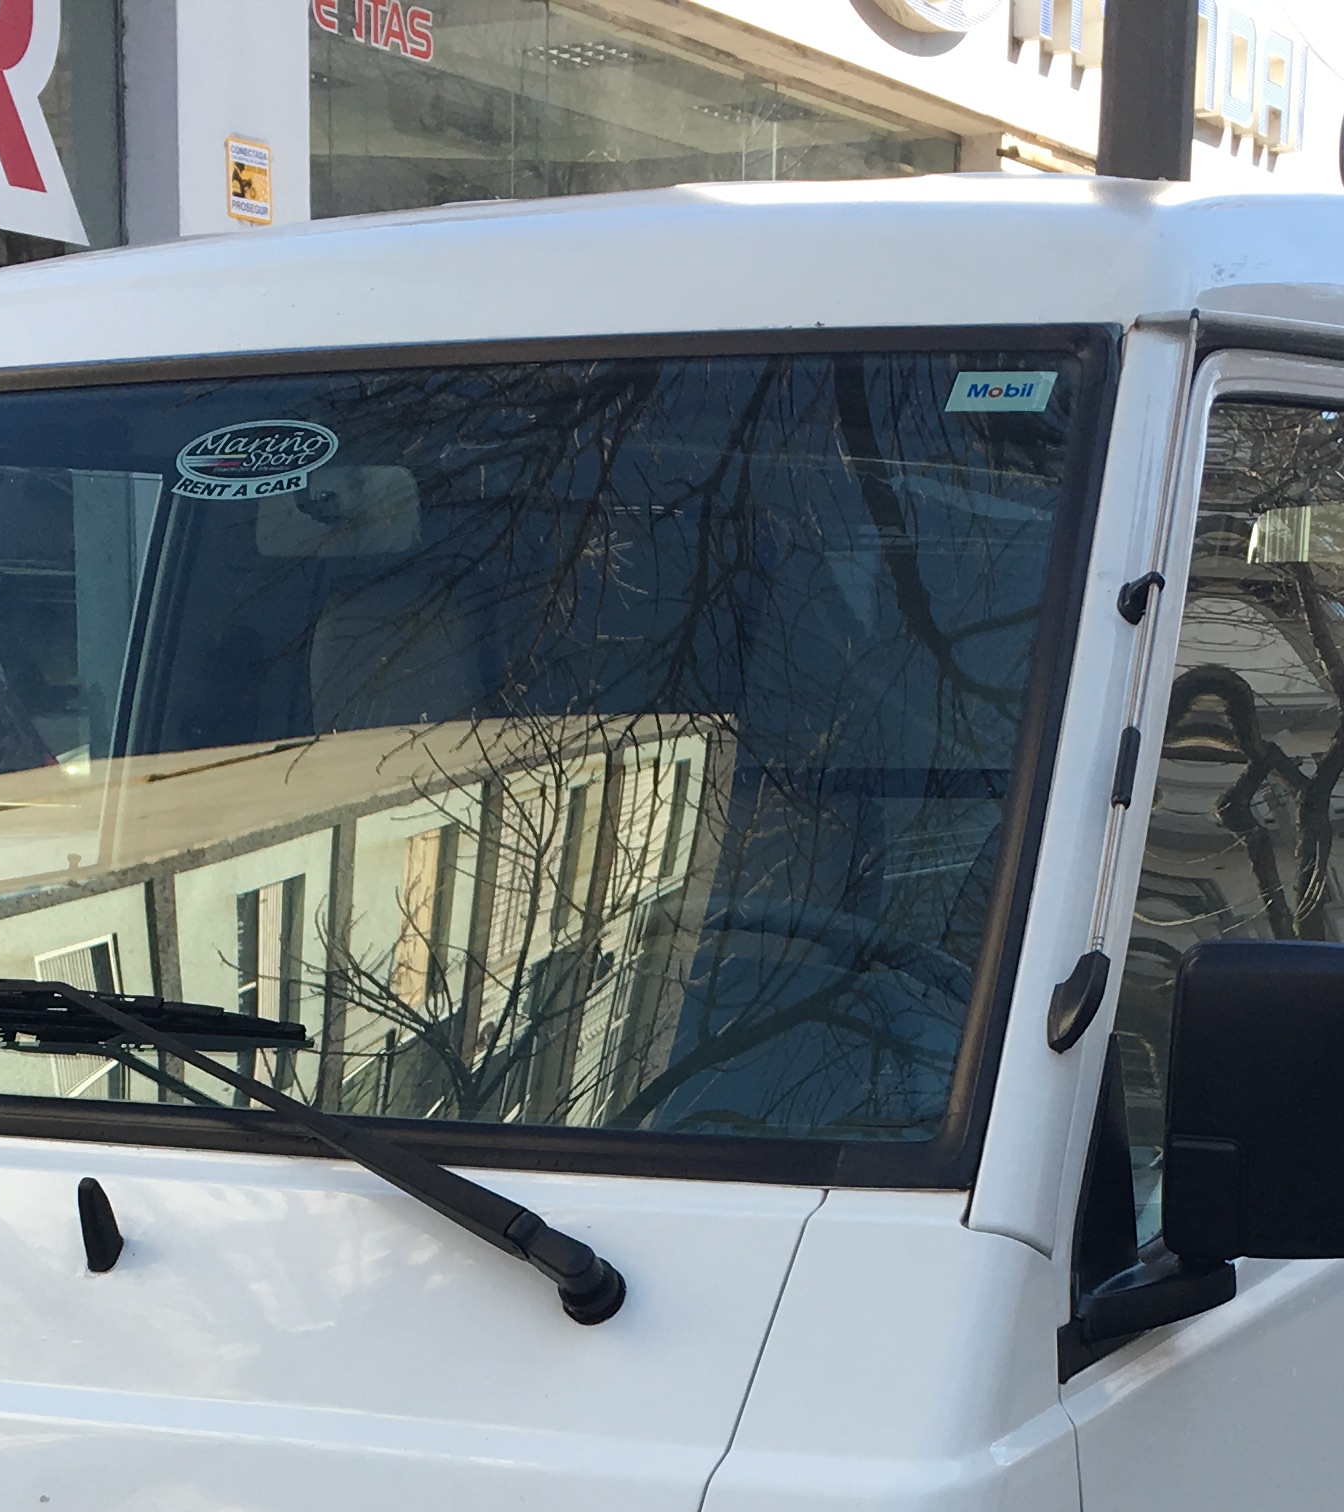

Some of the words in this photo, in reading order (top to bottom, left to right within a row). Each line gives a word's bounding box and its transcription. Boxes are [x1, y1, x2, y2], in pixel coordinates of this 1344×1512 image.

[966, 383, 1034, 398] Mobil
[196, 431, 329, 455] Mariño
[242, 450, 316, 471] Sport
[178, 477, 233, 497] RENT
[232, 484, 248, 497] A
[254, 476, 302, 495] CAR
